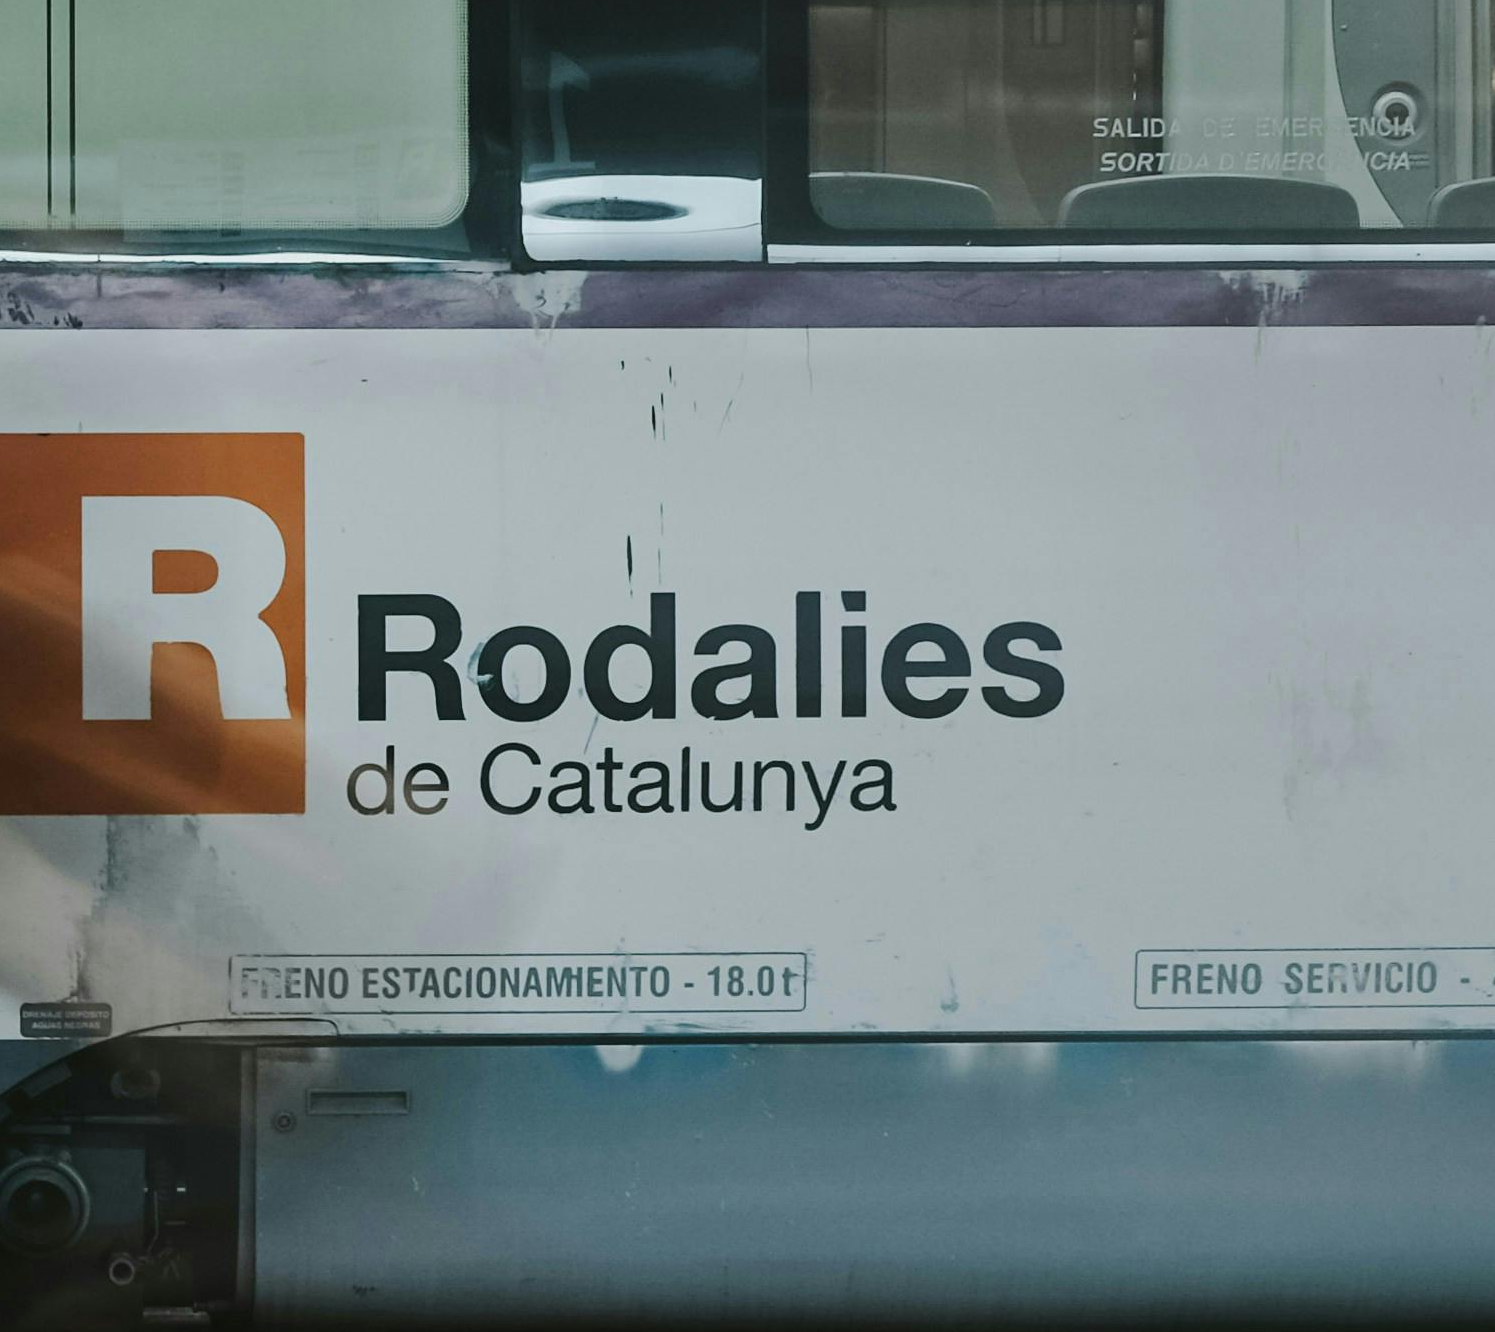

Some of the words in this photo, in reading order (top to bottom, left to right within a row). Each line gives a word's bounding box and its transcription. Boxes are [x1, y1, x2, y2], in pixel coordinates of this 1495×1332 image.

[1093, 117, 1180, 138] SALIDA
[1256, 117, 1416, 138] EMERENCIA
[1100, 152, 1208, 172] SORTIDA
[1218, 151, 1411, 172] D'EMERNCIA
[81, 494, 291, 720] R
[356, 591, 1066, 723] Rodalies
[346, 745, 449, 815] de
[479, 744, 897, 831] Catalunya
[362, 966, 670, 999] ESTACIONAMIENTO
[1151, 963, 1263, 995] FRENO
[1284, 961, 1438, 995] SERVICIO
